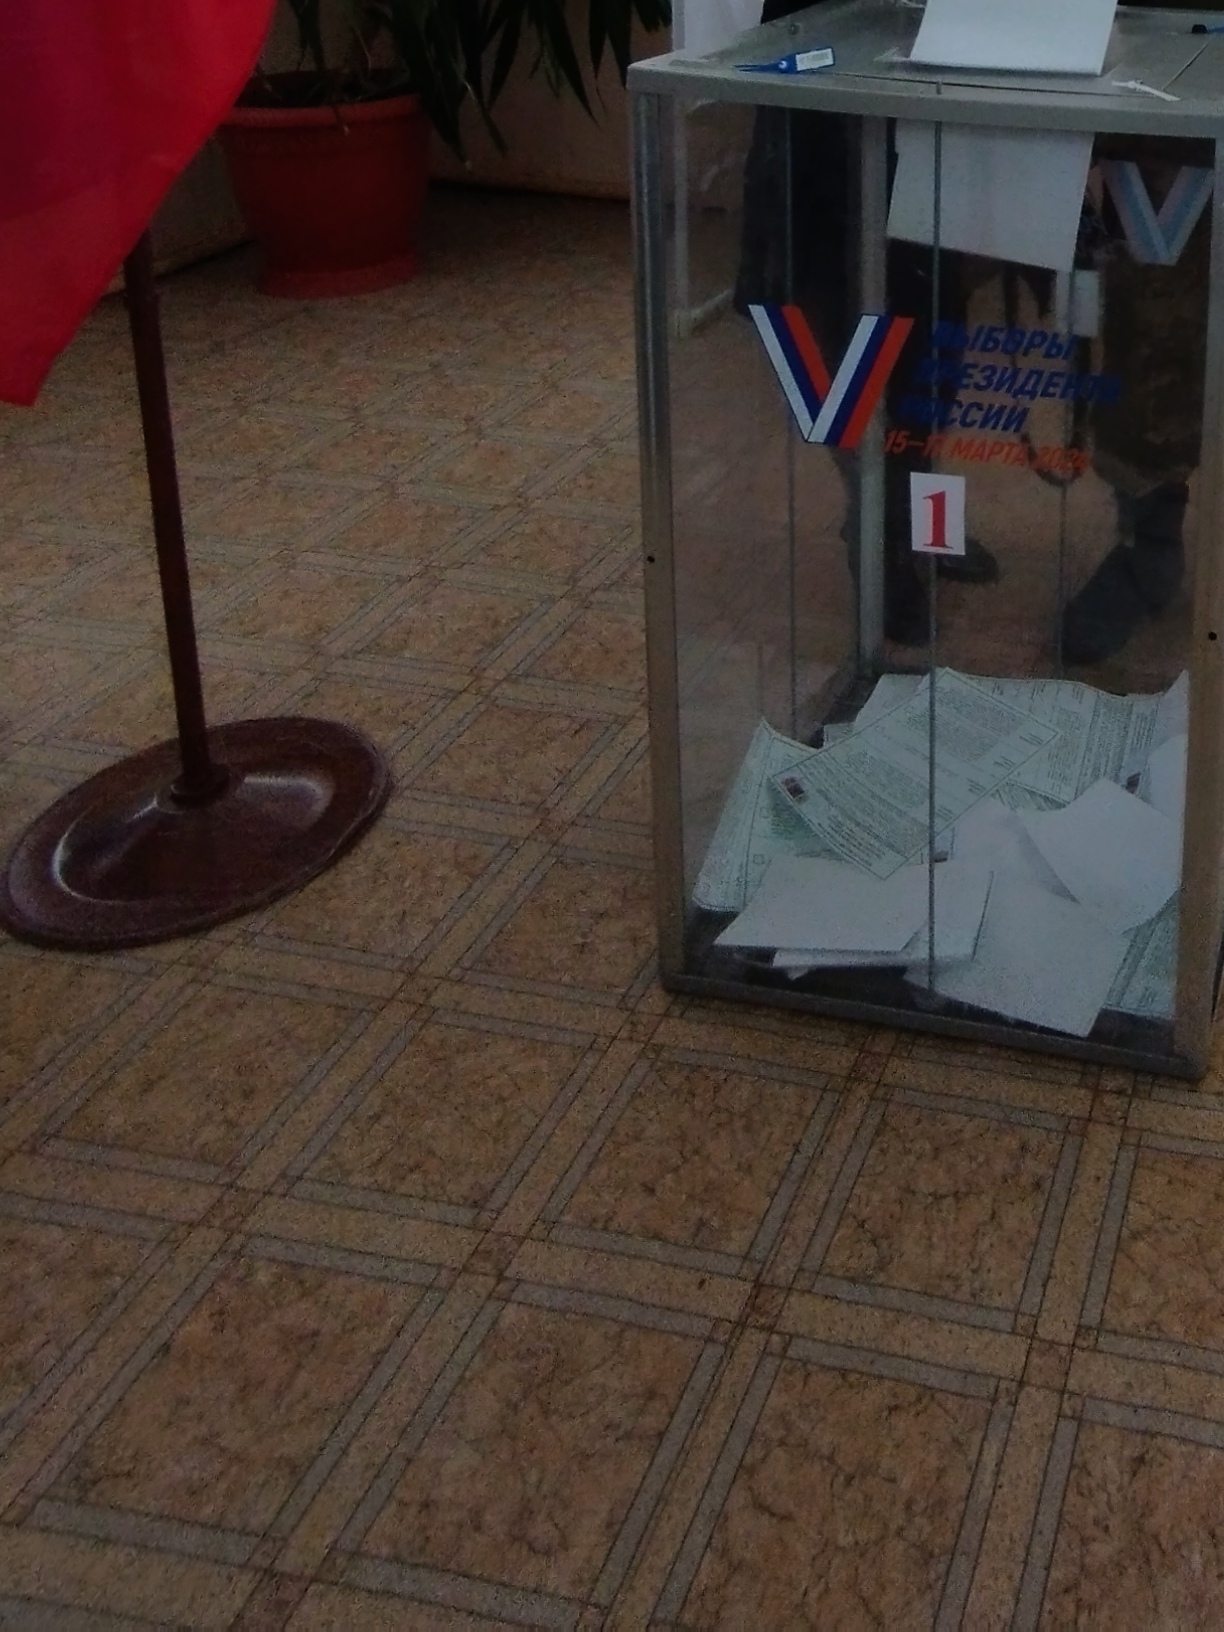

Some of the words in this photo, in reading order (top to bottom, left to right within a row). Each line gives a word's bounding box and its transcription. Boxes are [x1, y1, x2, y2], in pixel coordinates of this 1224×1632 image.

[932, 320, 1079, 360] ВЫБОРЫ
[898, 394, 1030, 432] РОССИИ
[949, 436, 1030, 466] МАРТА
[922, 489, 954, 550] 1
